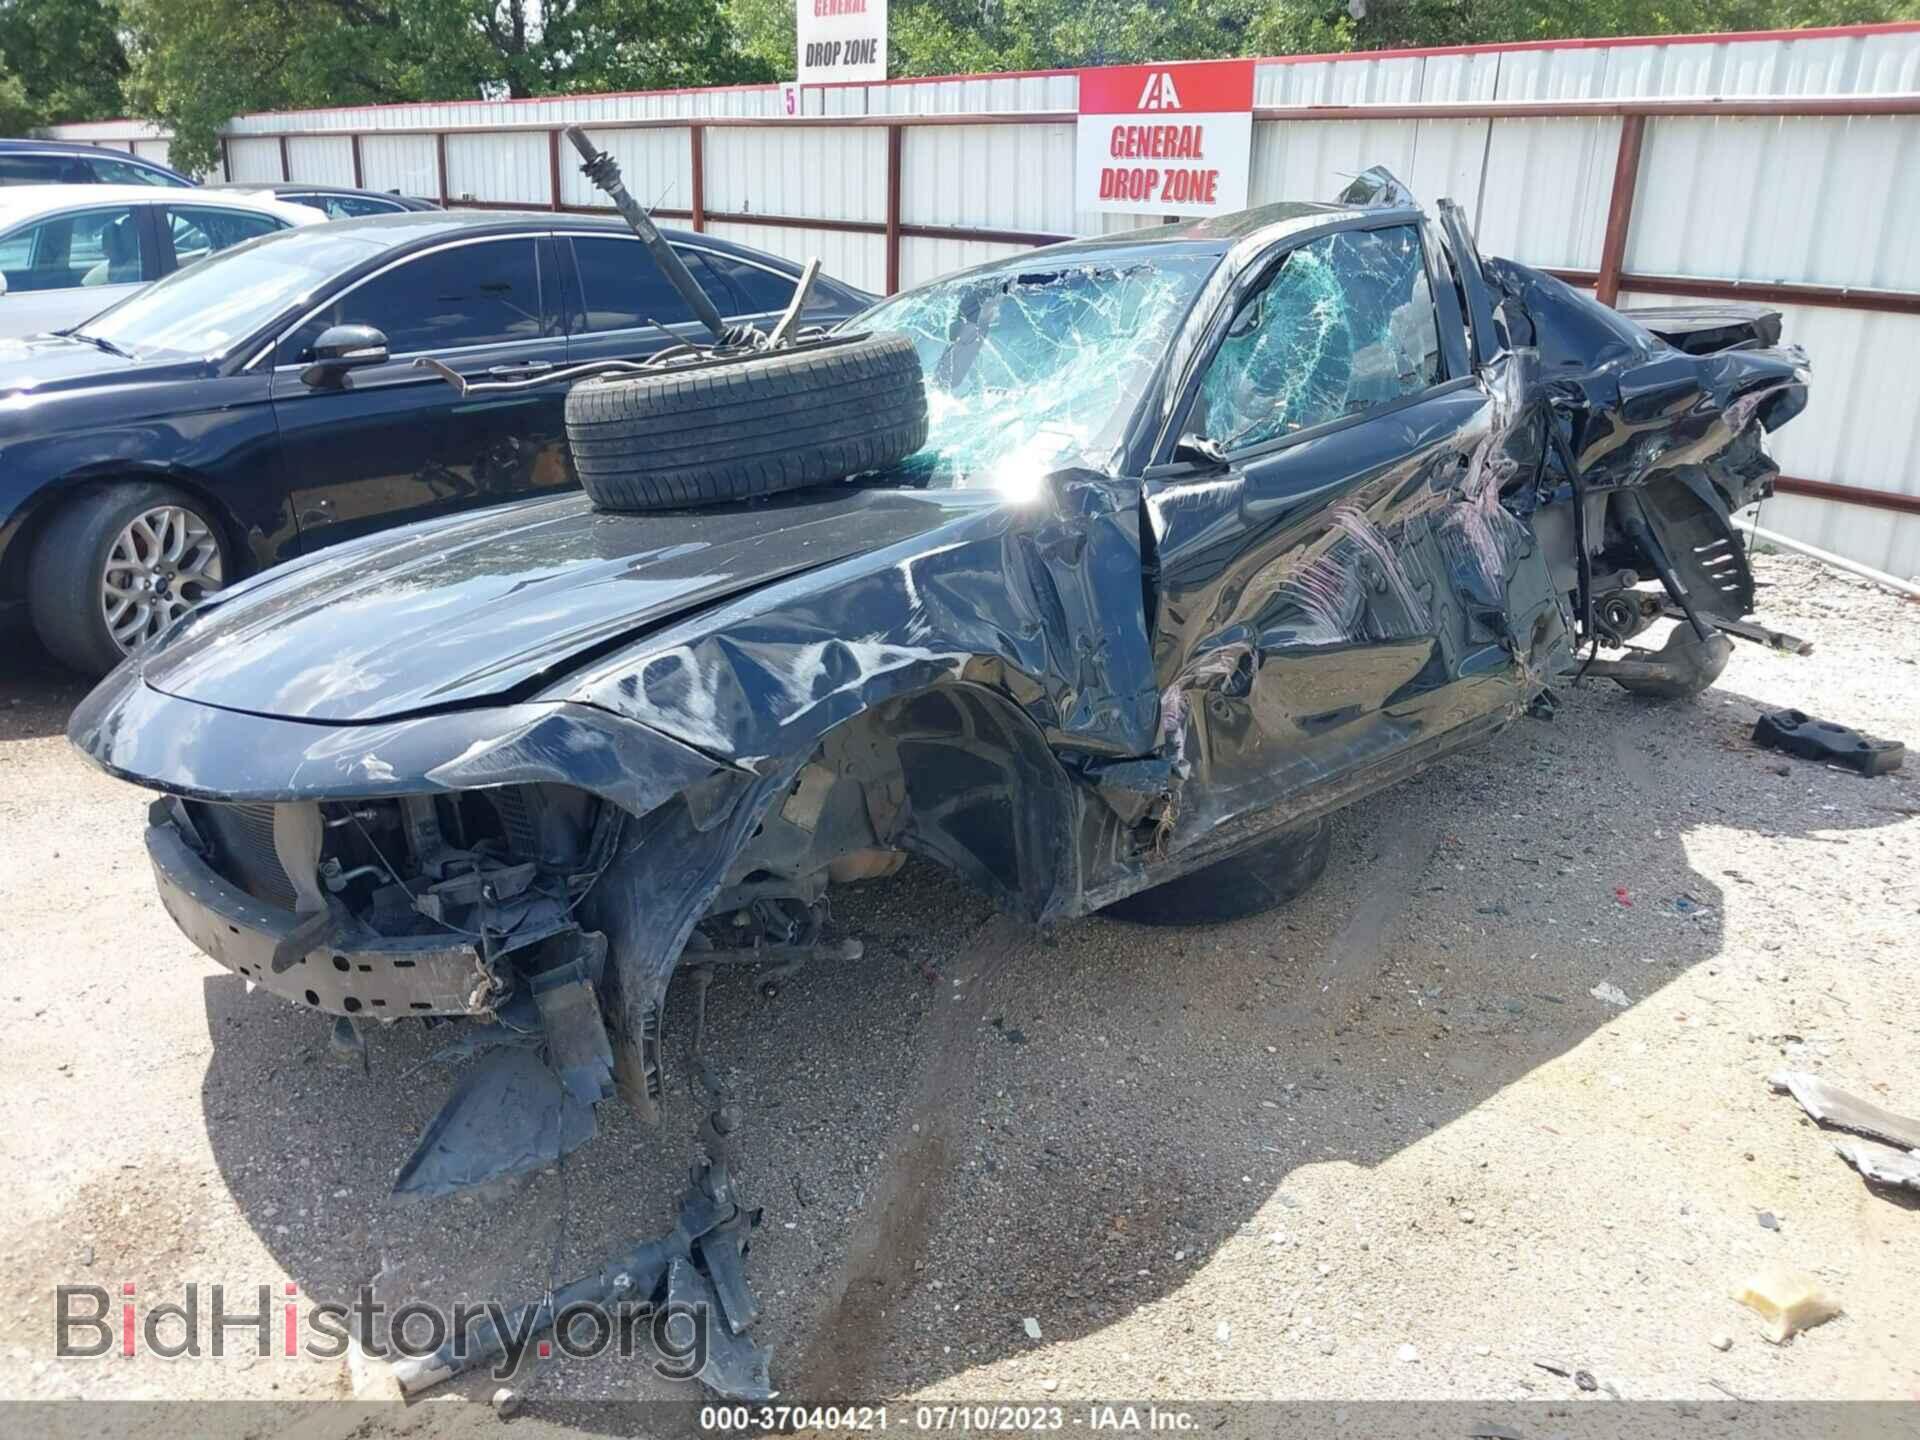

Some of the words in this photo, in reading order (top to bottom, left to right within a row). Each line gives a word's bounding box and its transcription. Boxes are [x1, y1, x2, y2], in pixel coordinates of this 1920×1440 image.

[805, 41, 841, 67] DROP
[843, 38, 877, 65] ZONE
[786, 88, 795, 115] 5
[1110, 125, 1204, 160] GENERAL
[1099, 168, 1160, 201] DROP
[1160, 169, 1219, 204] ZONE
